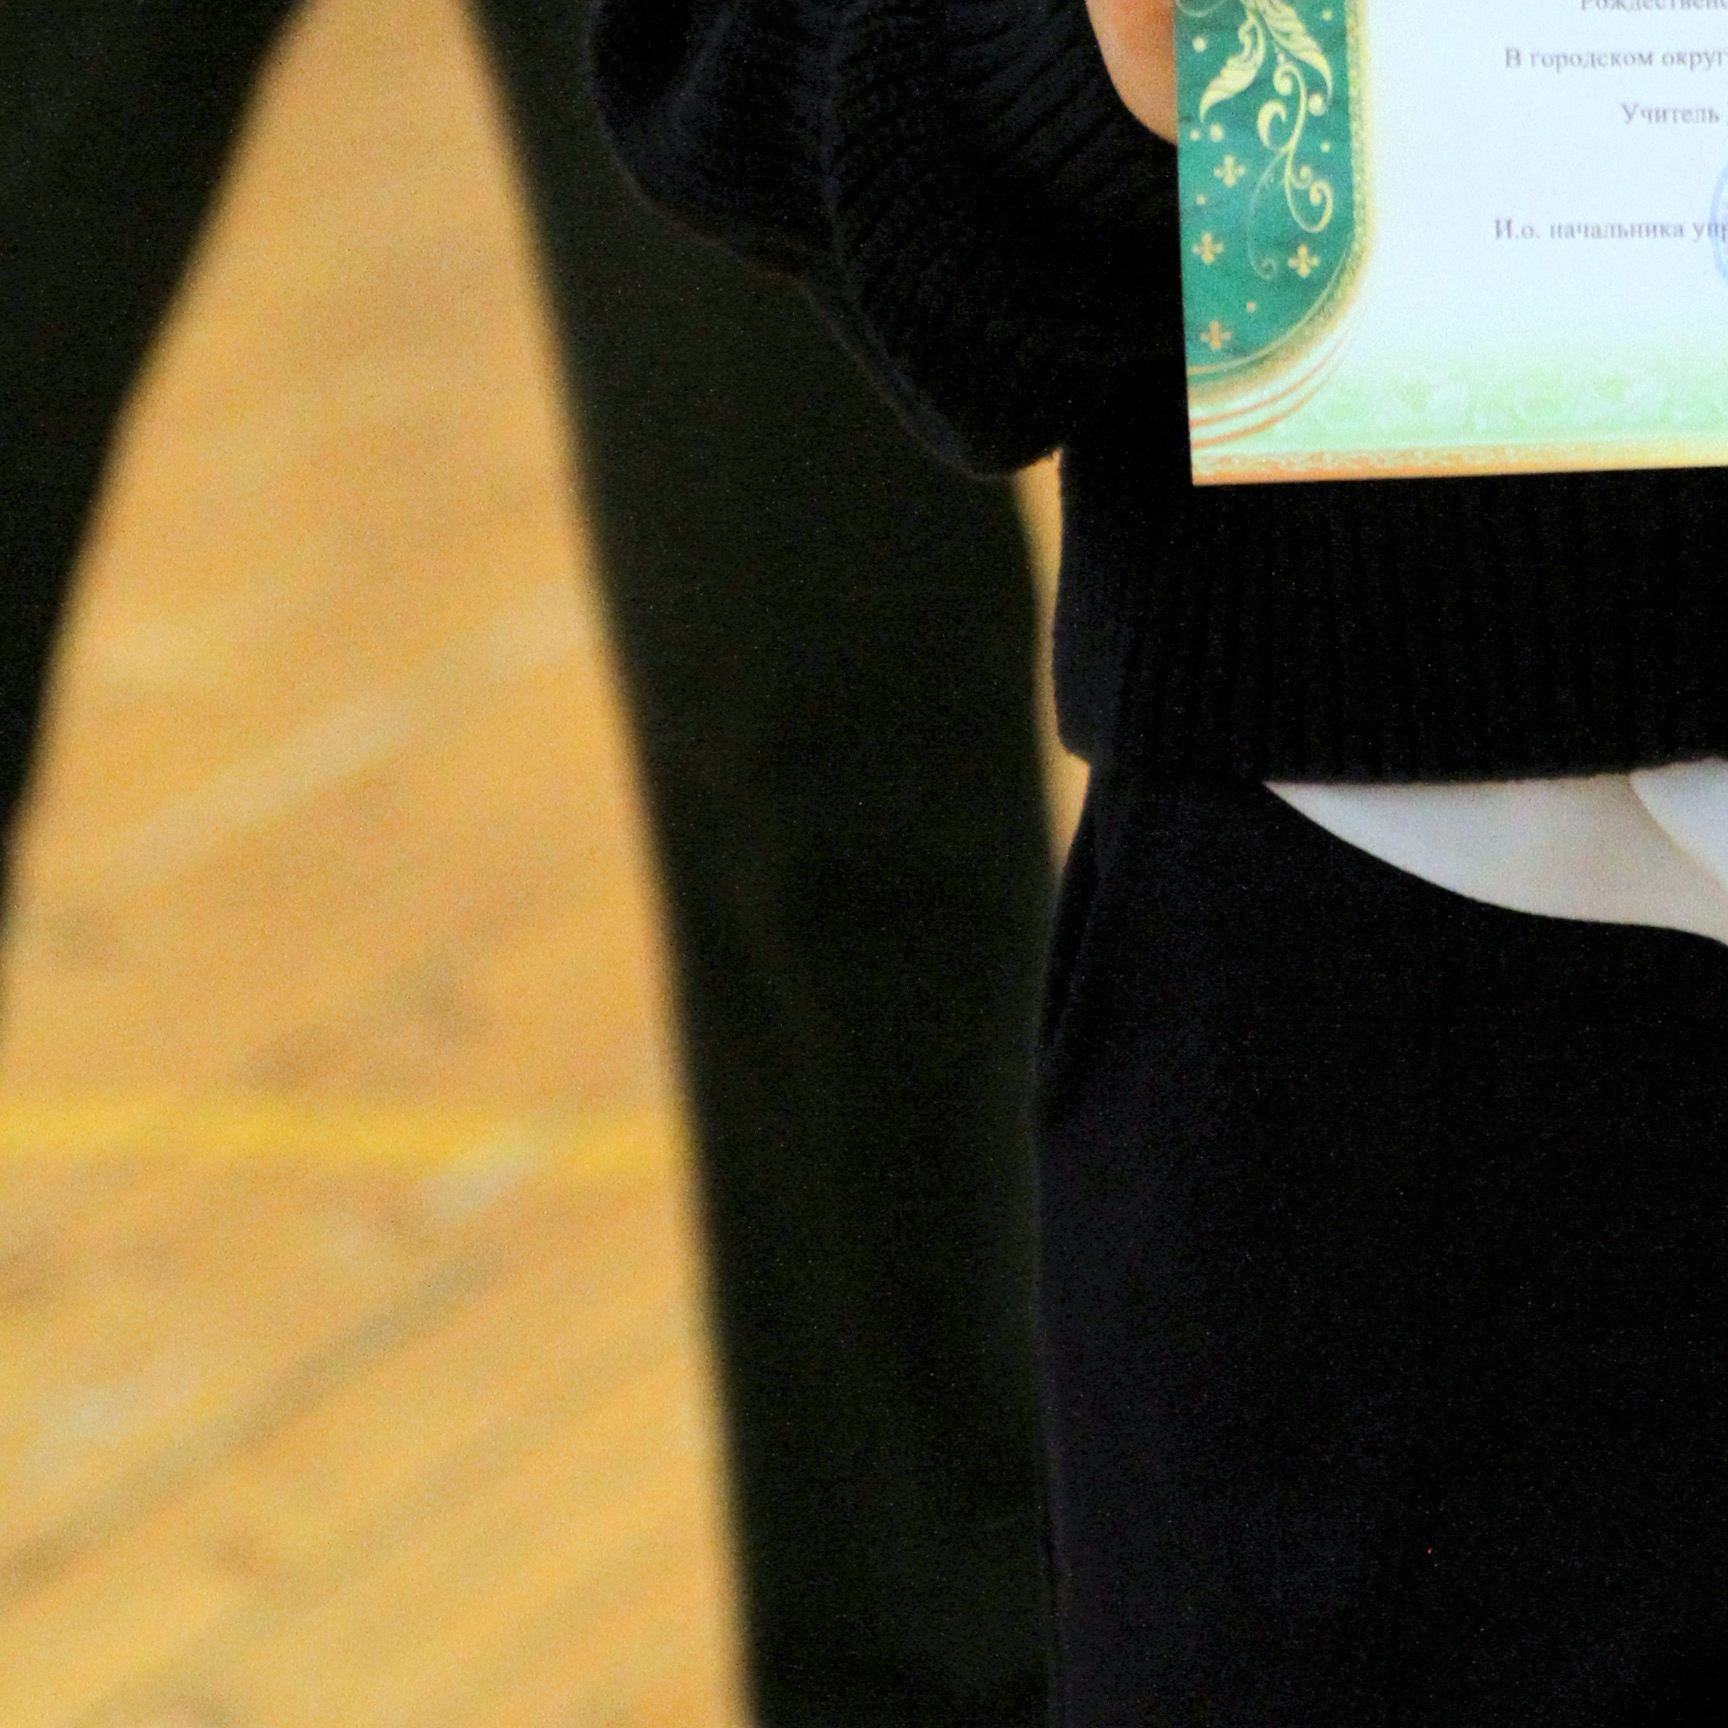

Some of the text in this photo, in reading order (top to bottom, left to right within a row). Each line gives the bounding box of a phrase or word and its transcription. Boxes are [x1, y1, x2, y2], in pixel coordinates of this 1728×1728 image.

[1504, 45, 1523, 69] В
[1529, 50, 1654, 74] городском
[1620, 102, 1721, 125] Учитель
[1493, 217, 1540, 241] И.о.
[1549, 221, 1686, 241] начальника
